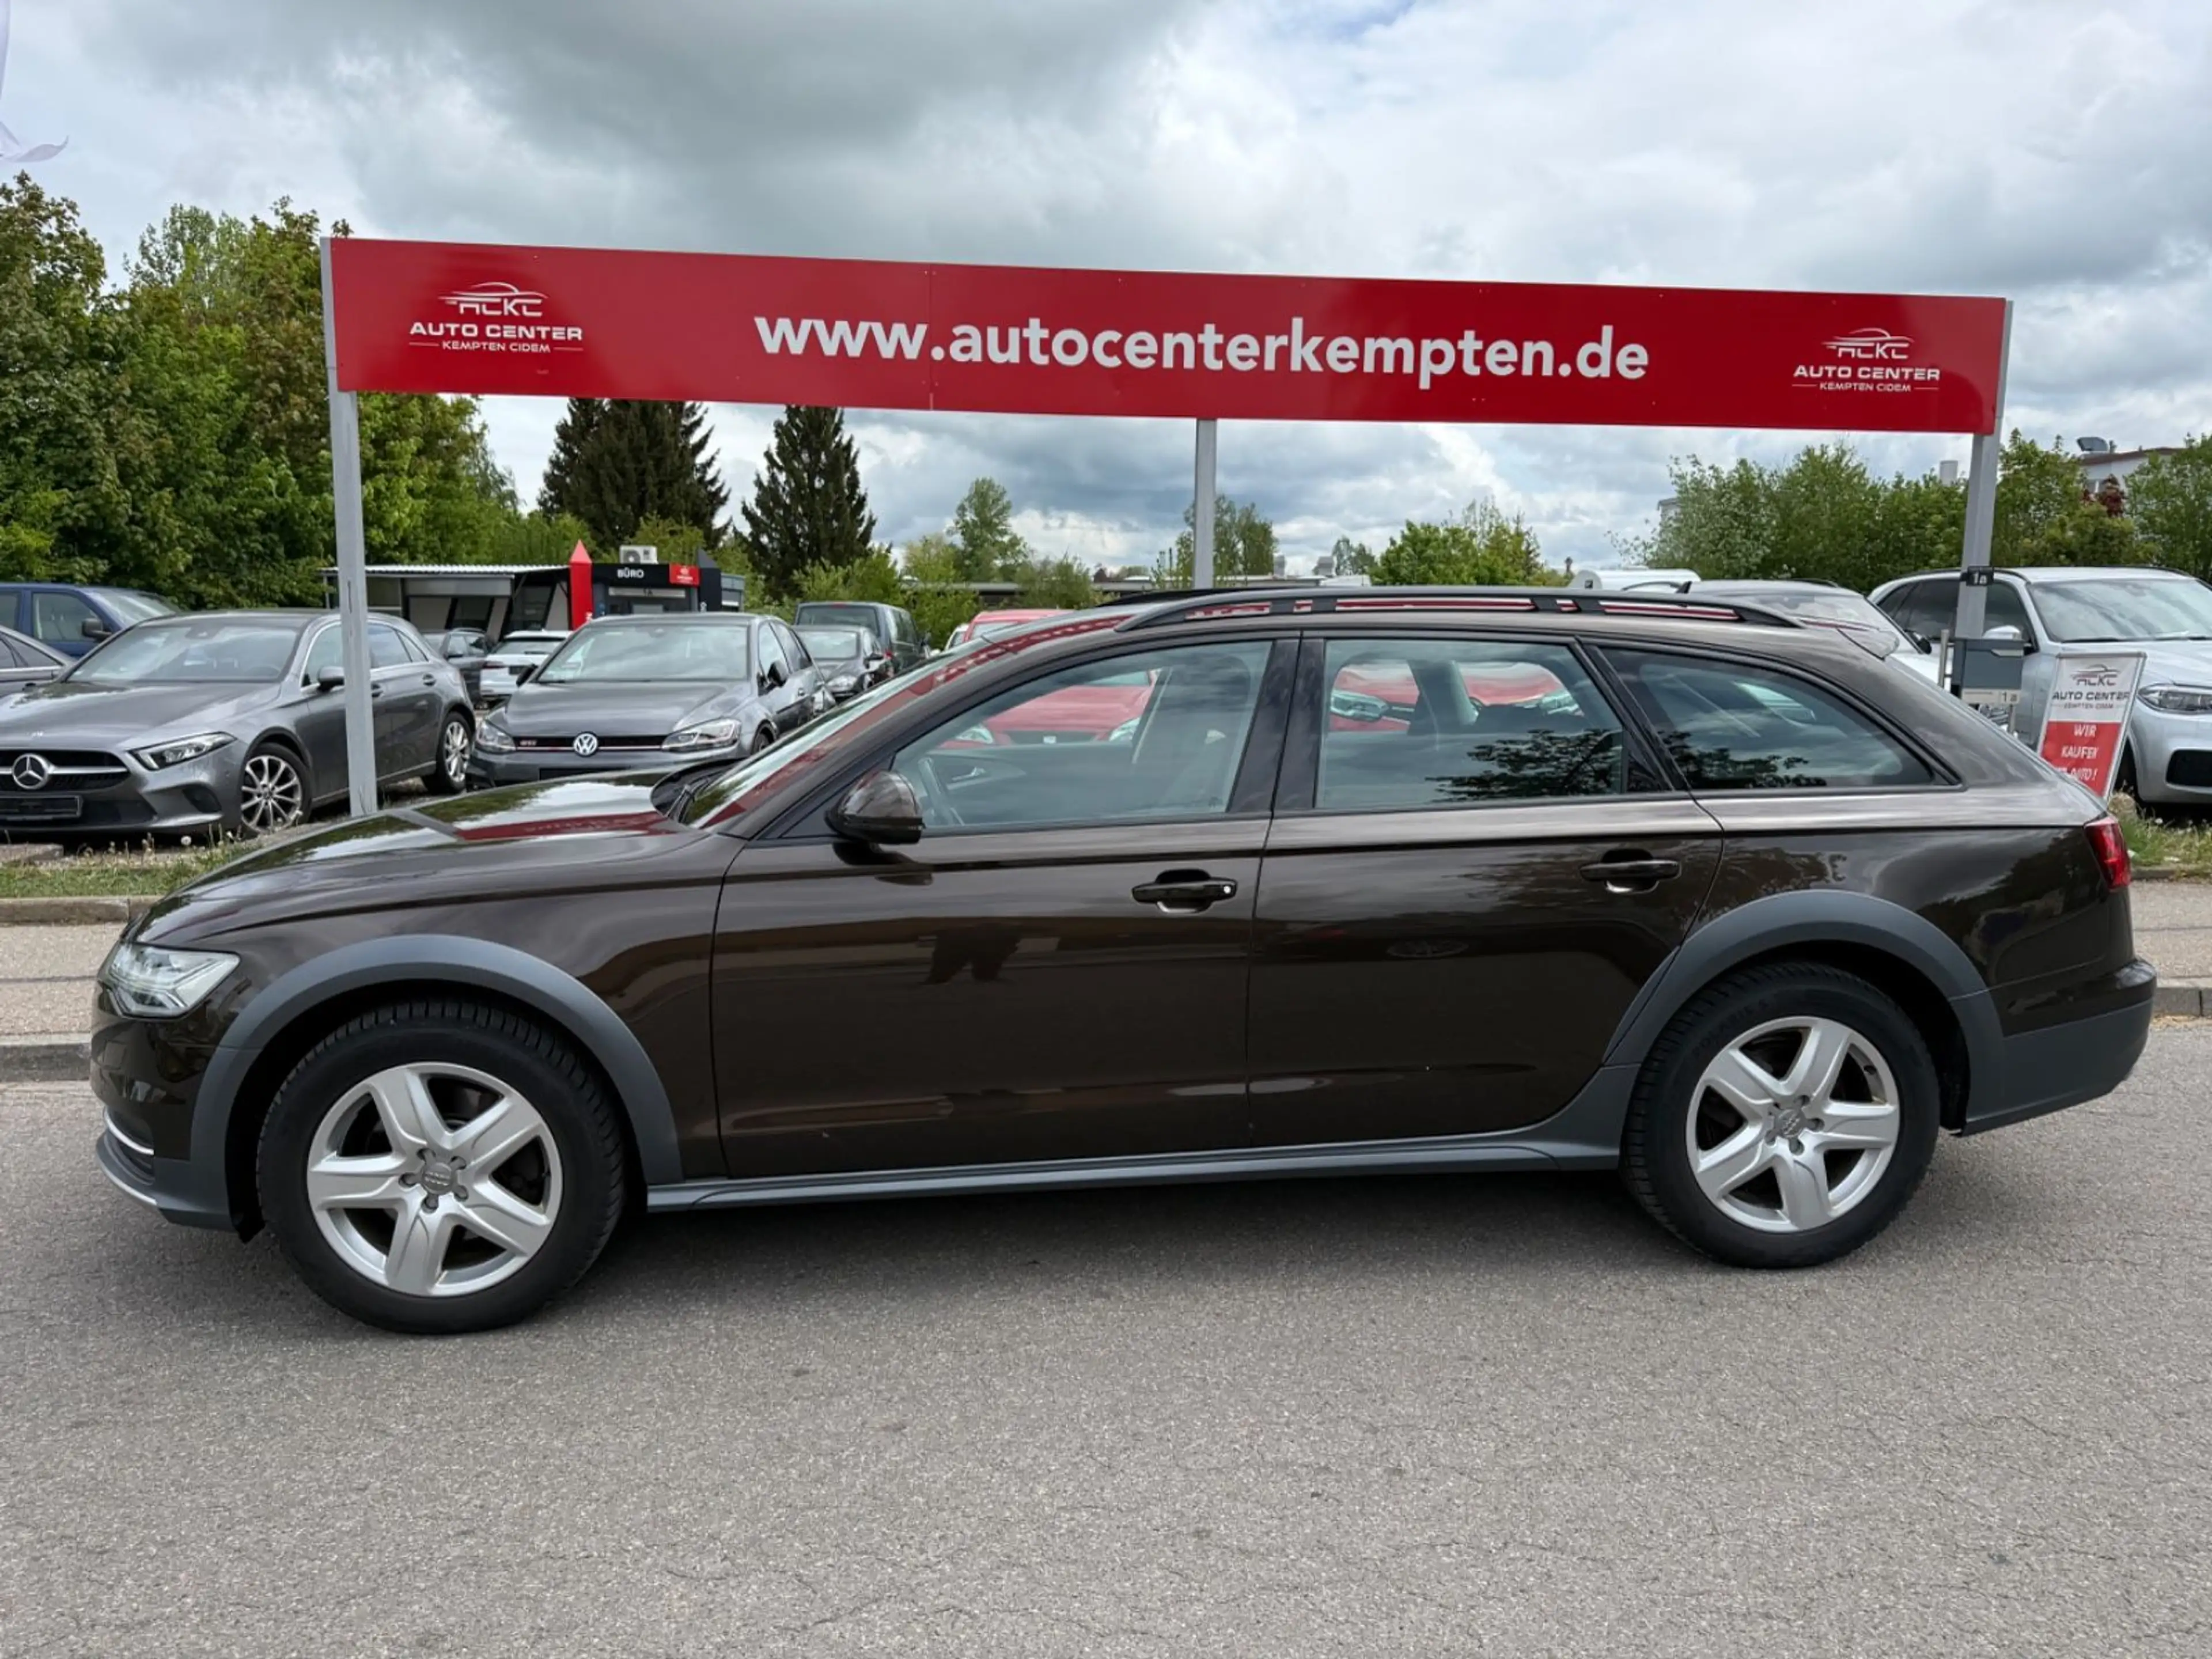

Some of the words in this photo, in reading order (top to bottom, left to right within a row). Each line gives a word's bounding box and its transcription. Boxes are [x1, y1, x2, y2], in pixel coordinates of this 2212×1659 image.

[410, 321, 479, 337] AUTO
[485, 324, 583, 341] CENTER
[441, 339, 506, 351] KEMPTEN
[509, 342, 551, 353] CIDEM
[753, 316, 1649, 391] www.autocenterkempten.de
[1793, 365, 1853, 378] AUTO
[1857, 366, 1941, 381] CENTER
[1819, 381, 1874, 391] KEMPTEN
[616, 567, 645, 579] BÜRO
[2052, 691, 2083, 700] AUTO
[2085, 691, 2131, 701] CENTER
[2074, 724, 2097, 737] WIR
